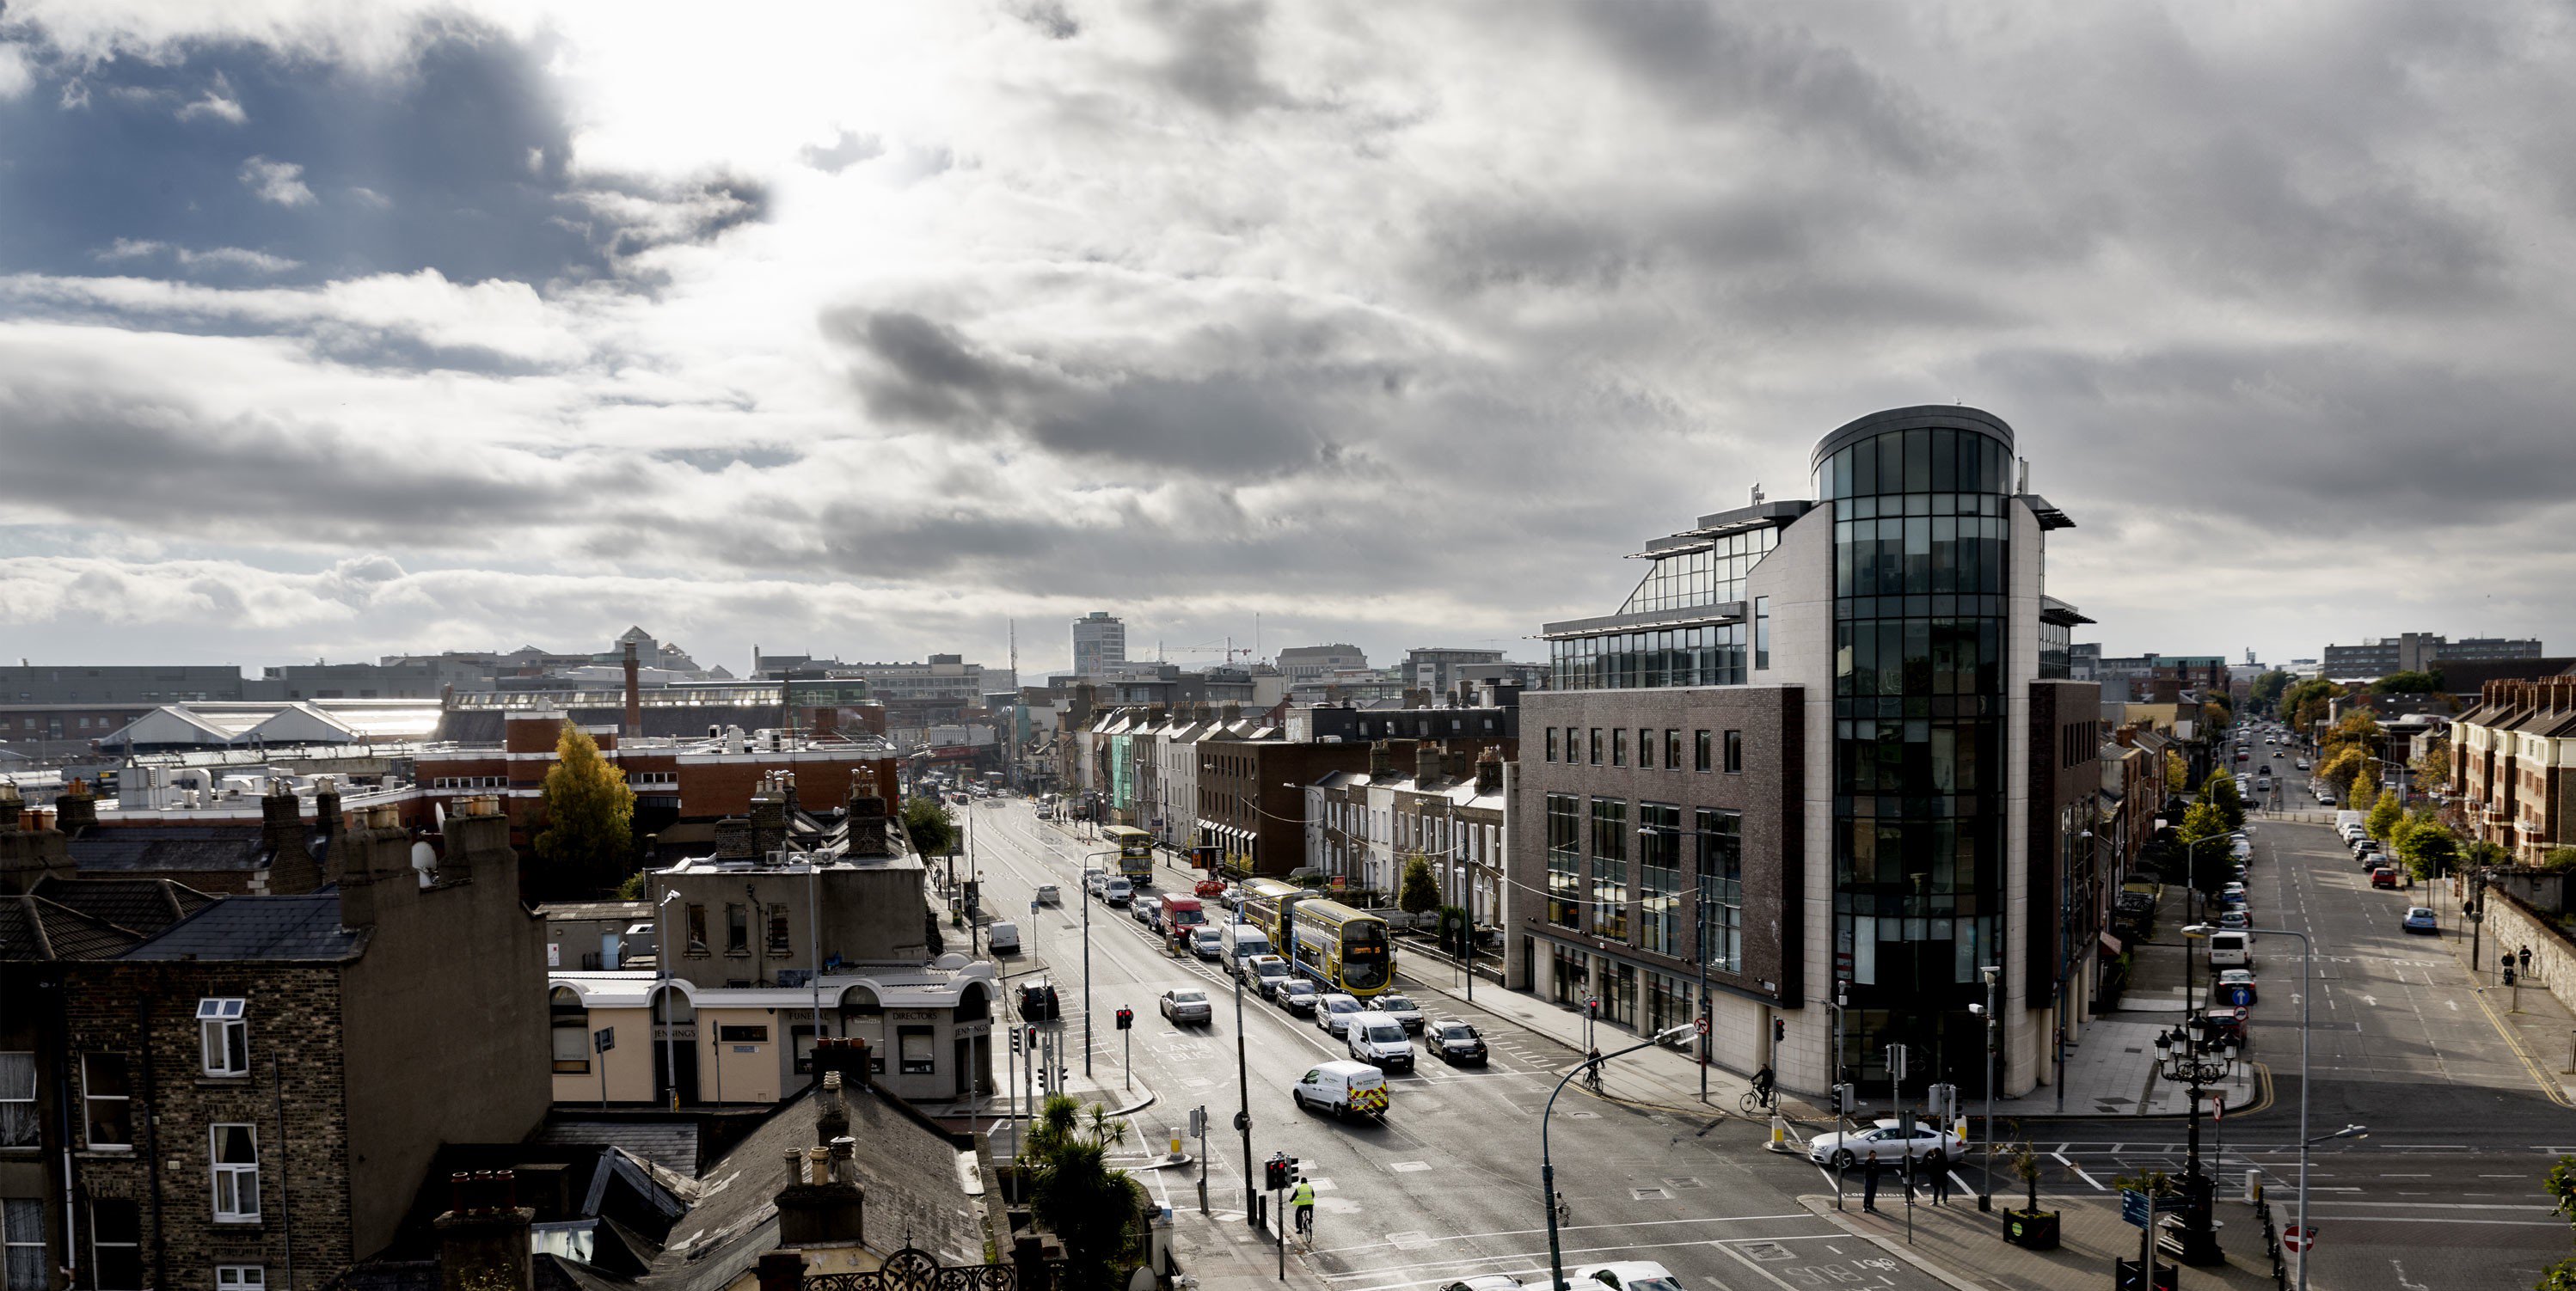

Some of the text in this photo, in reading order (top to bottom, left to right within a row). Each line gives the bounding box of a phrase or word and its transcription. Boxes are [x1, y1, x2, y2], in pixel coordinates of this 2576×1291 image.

[788, 1012, 937, 1020] FUNEAL DIRECTORS
[654, 1030, 696, 1038] JENINGS
[1168, 1051, 1214, 1061] BUS
[1784, 1263, 1867, 1285] BUS
